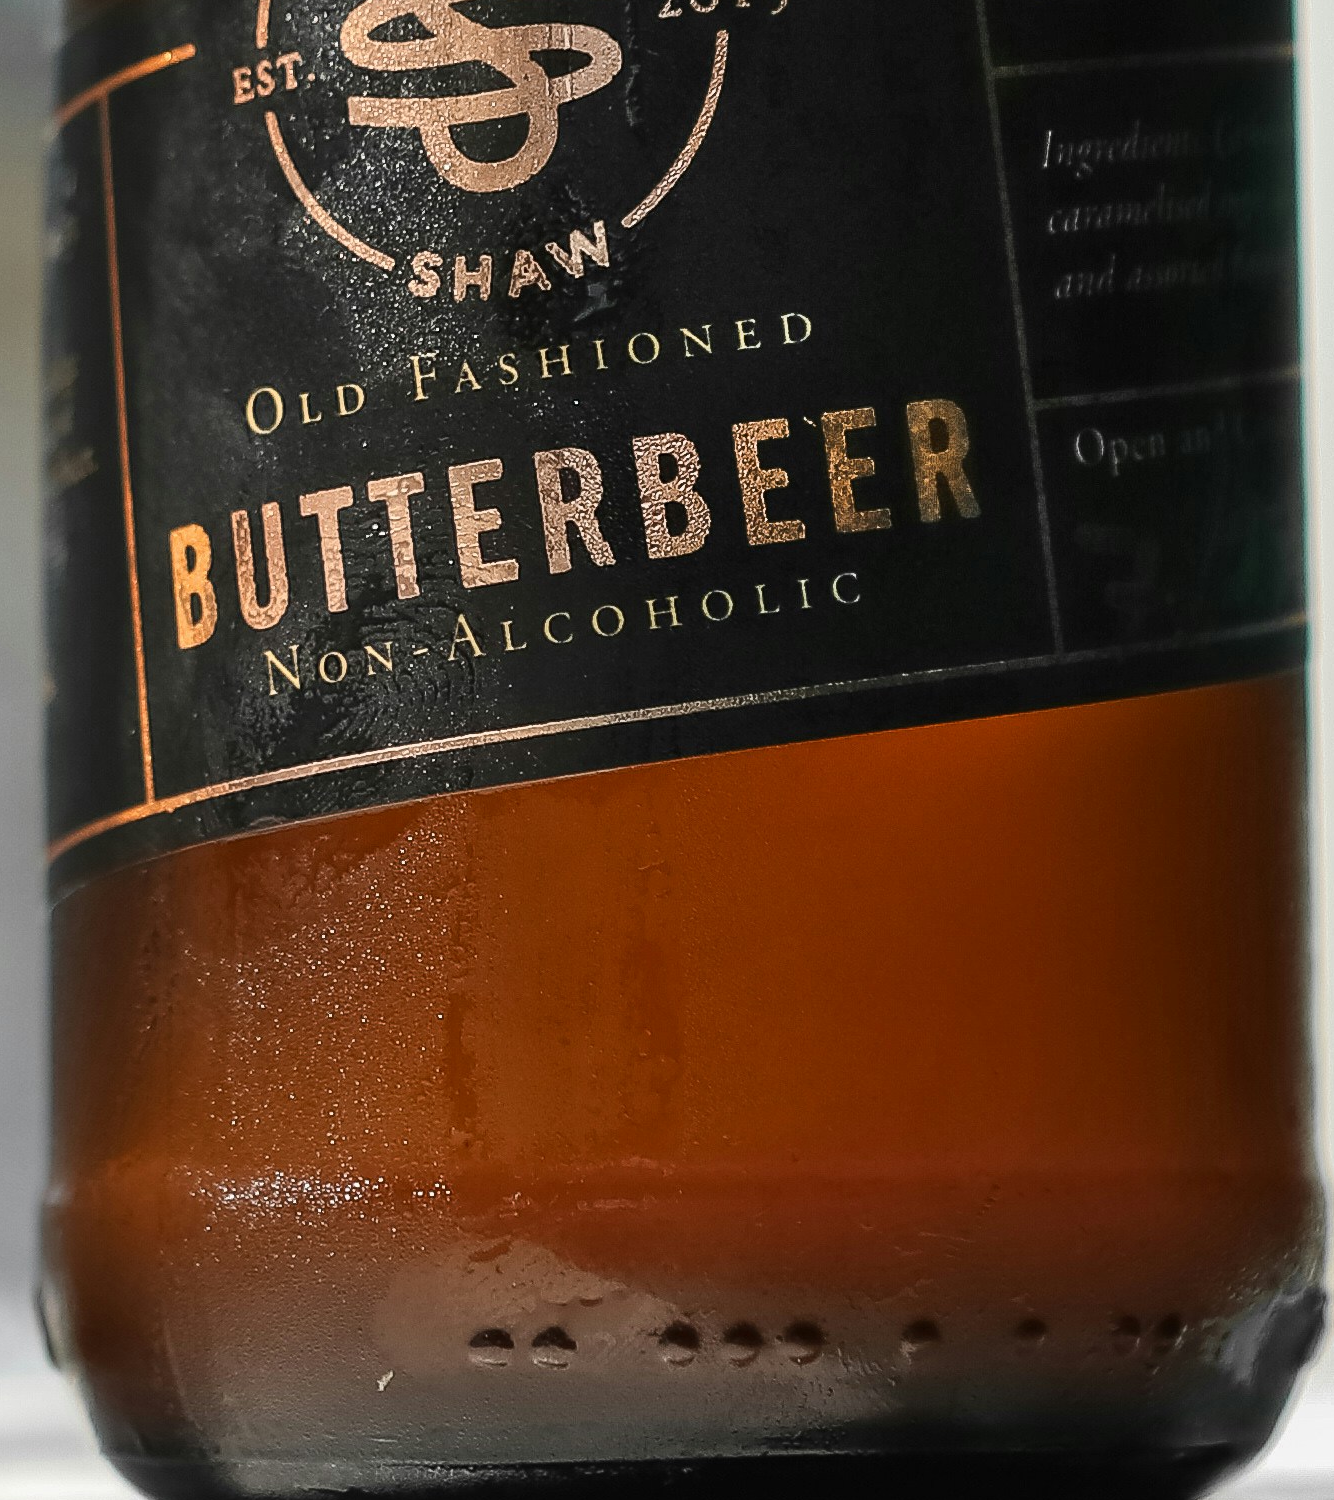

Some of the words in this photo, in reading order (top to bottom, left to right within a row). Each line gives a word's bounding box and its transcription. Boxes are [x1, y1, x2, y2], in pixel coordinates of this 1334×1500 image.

[232, 53, 317, 106] EST.
[407, 220, 611, 302] SHAW
[1073, 427, 1166, 478] Open
[169, 398, 981, 650] BUTTERBEER
